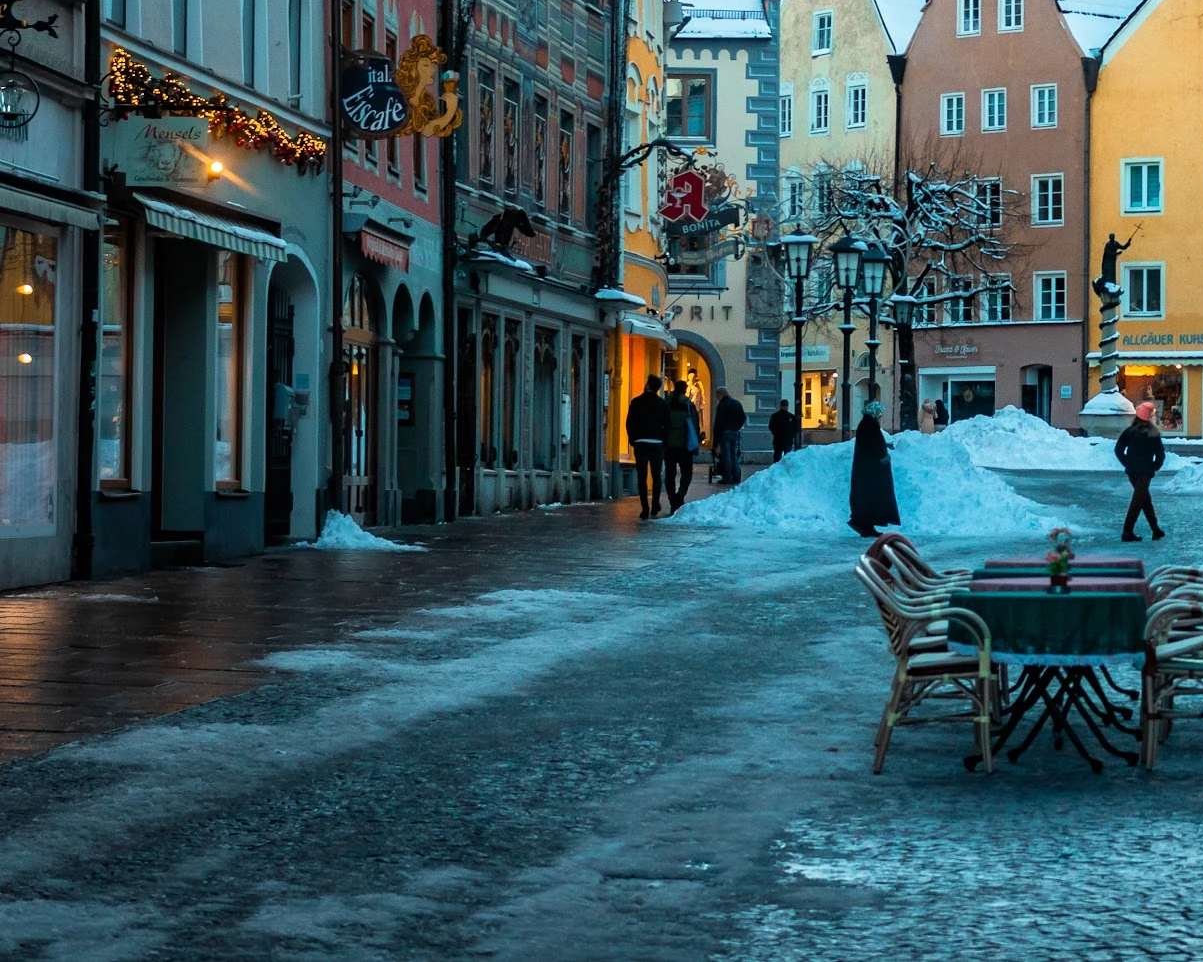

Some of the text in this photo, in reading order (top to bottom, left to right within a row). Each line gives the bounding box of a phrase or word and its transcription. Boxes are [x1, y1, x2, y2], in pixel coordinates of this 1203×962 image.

[368, 64, 392, 83] ital.
[342, 84, 405, 131] Eiscafé
[682, 219, 721, 234] BONITA
[672, 305, 733, 321] PRIT
[1122, 331, 1174, 346] ALLGÄUER
